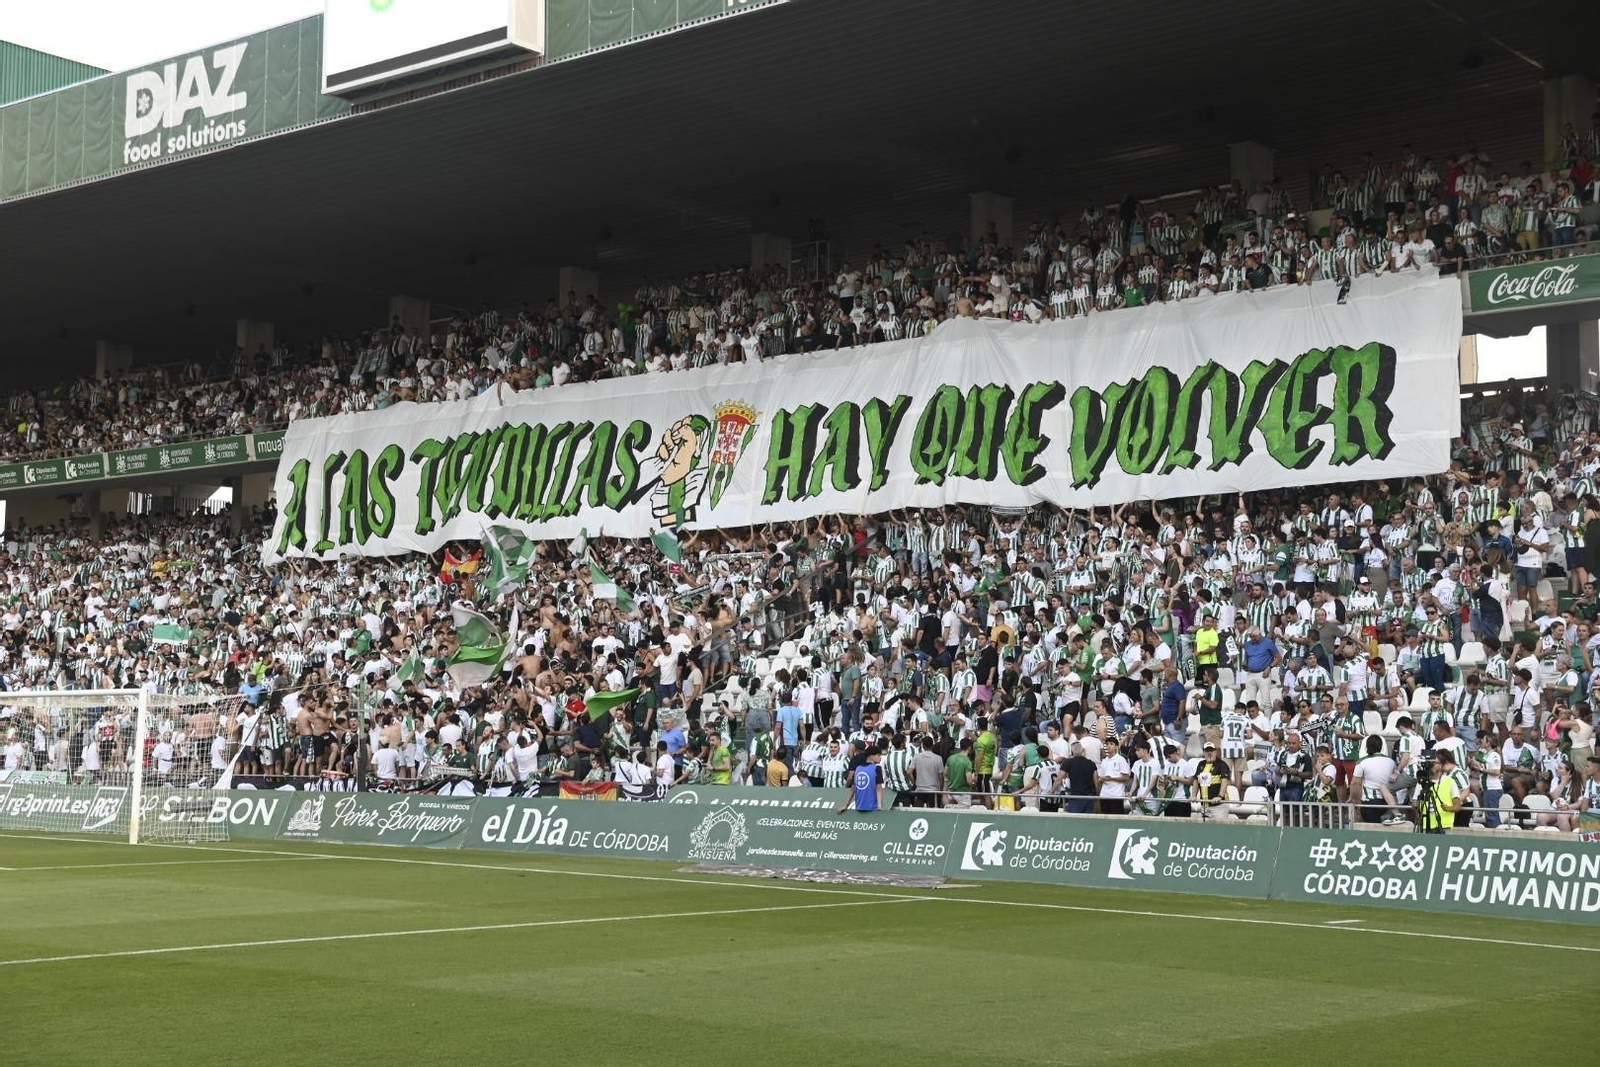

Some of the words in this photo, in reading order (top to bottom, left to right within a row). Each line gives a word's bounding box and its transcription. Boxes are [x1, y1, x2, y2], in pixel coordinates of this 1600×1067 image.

[125, 42, 248, 138] DIAZ
[124, 132, 161, 164] food
[167, 119, 246, 154] solutions
[1487, 263, 1579, 304] Coca-Cola
[276, 458, 310, 557] A
[312, 444, 405, 557] LAS
[761, 395, 912, 506] HAY
[910, 380, 1066, 487] QUE
[1068, 341, 1397, 490] VOLVER
[1227, 722, 1243, 738] 12
[6, 793, 91, 818] rg3print.es
[481, 804, 516, 843] el
[512, 805, 569, 845] Día
[569, 830, 591, 847] DE
[593, 829, 669, 852] CÓRDOBA
[794, 831, 820, 839] MUCHO
[820, 830, 838, 840] MÁS
[816, 819, 851, 830] EVENTOS,
[853, 822, 878, 830] BODAS
[880, 823, 886, 831] Y
[883, 842, 945, 857] CILLERO
[1014, 835, 1094, 853] Diputación
[1167, 842, 1257, 862] Diputación
[823, 851, 878, 862] cillerocatering.es
[888, 857, 934, 866] CATERING
[1009, 854, 1028, 868] de
[1031, 854, 1091, 871] Córdoba
[1445, 846, 1600, 880] PATRIMON
[1163, 861, 1183, 877] de
[1187, 862, 1254, 881] Córdoba
[1303, 870, 1418, 900] CÓRDOBA
[1439, 873, 1600, 912] HUMANID
